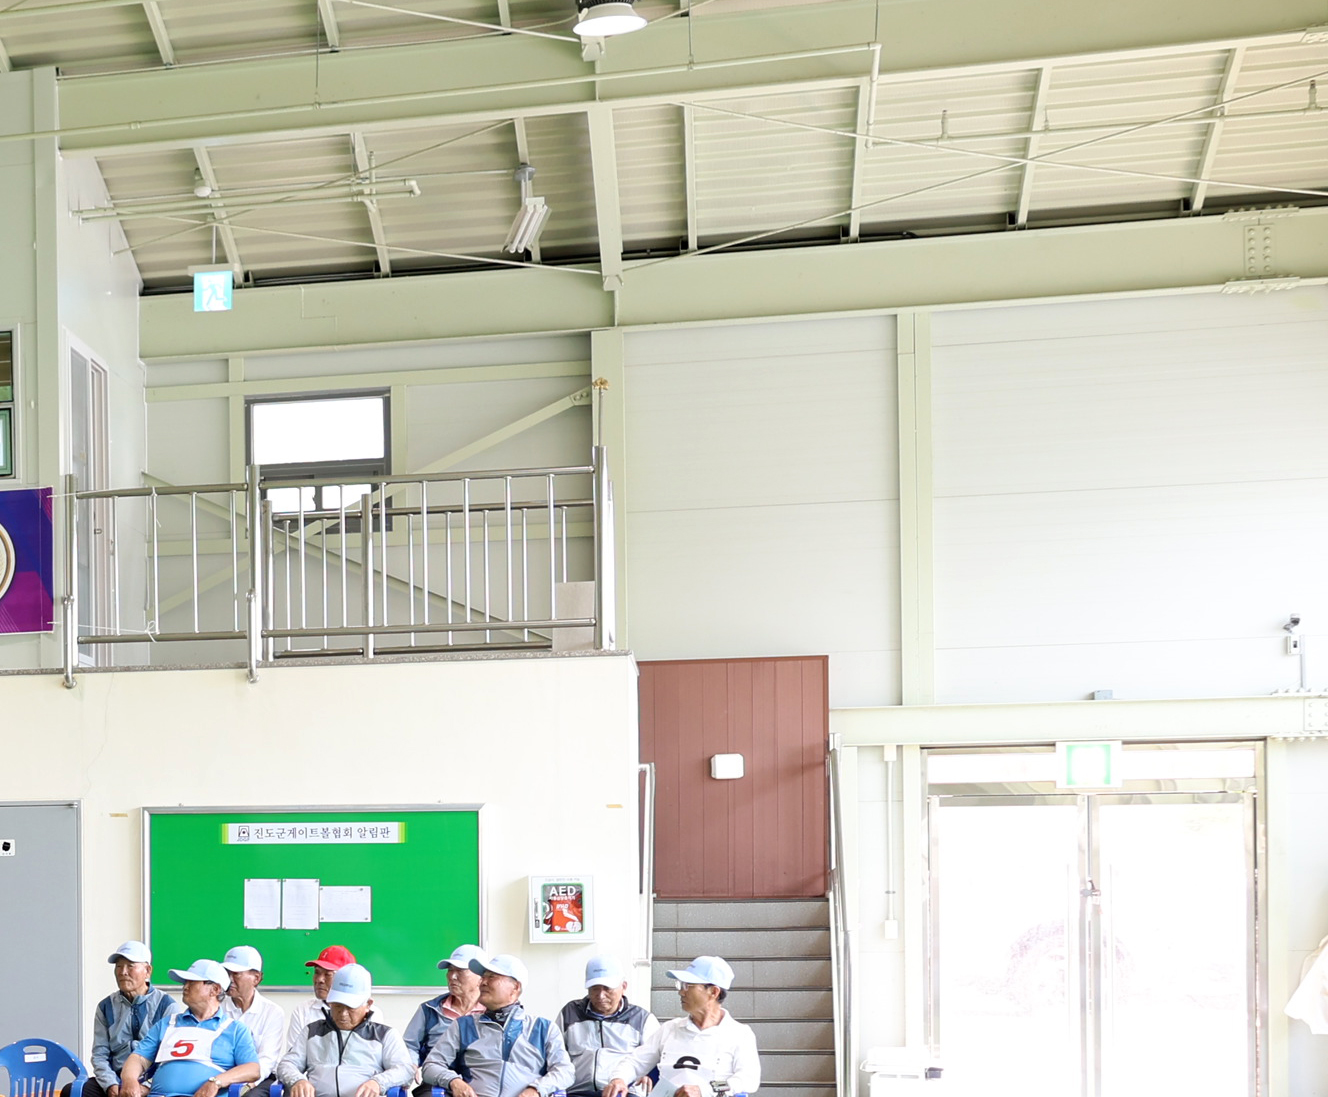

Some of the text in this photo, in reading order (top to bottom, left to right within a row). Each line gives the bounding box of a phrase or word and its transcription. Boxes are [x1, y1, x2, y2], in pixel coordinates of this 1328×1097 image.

[253, 826, 391, 840] 진도군게이트볼협회 알림판
[549, 885, 576, 896] AED
[170, 1038, 195, 1058] 5
